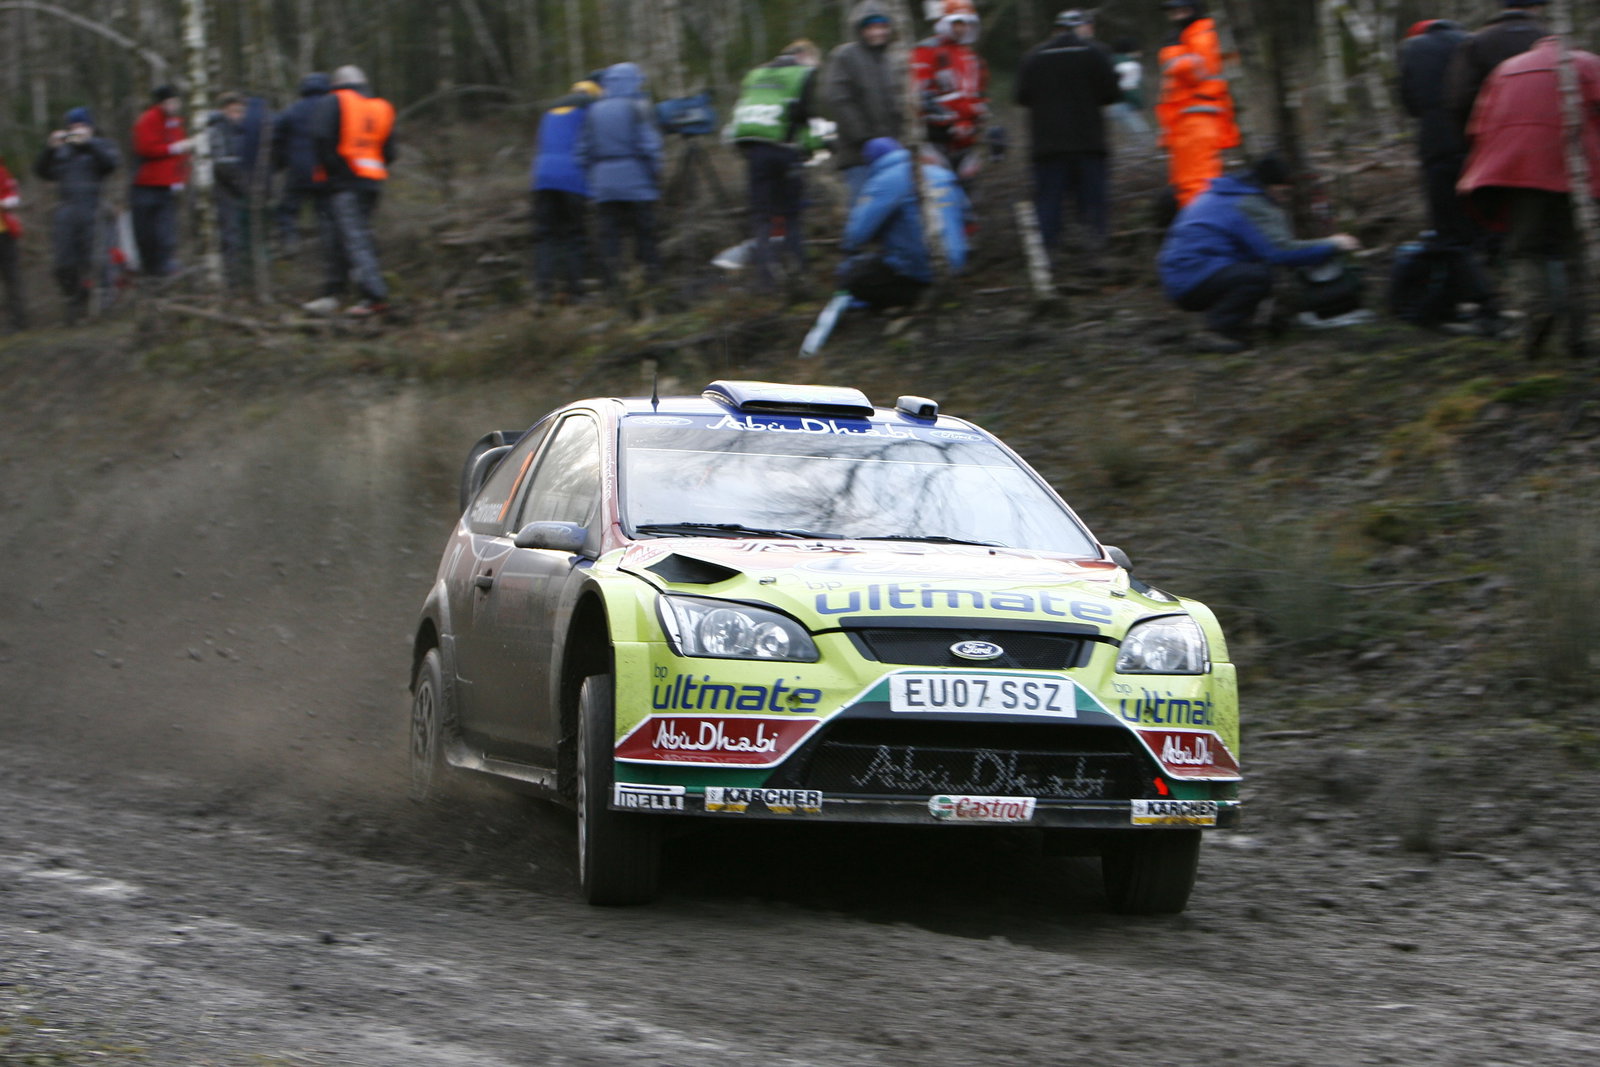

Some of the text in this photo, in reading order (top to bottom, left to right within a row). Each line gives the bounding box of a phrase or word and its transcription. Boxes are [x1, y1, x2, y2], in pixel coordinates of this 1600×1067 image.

[815, 583, 1112, 625] ultimate
[961, 641, 995, 655] Ford
[654, 664, 668, 682] bp
[652, 674, 823, 713] ultimate
[904, 678, 1063, 712] EU07 SSZ
[613, 782, 687, 811] PIRELLI
[955, 797, 1029, 819] Castrol
